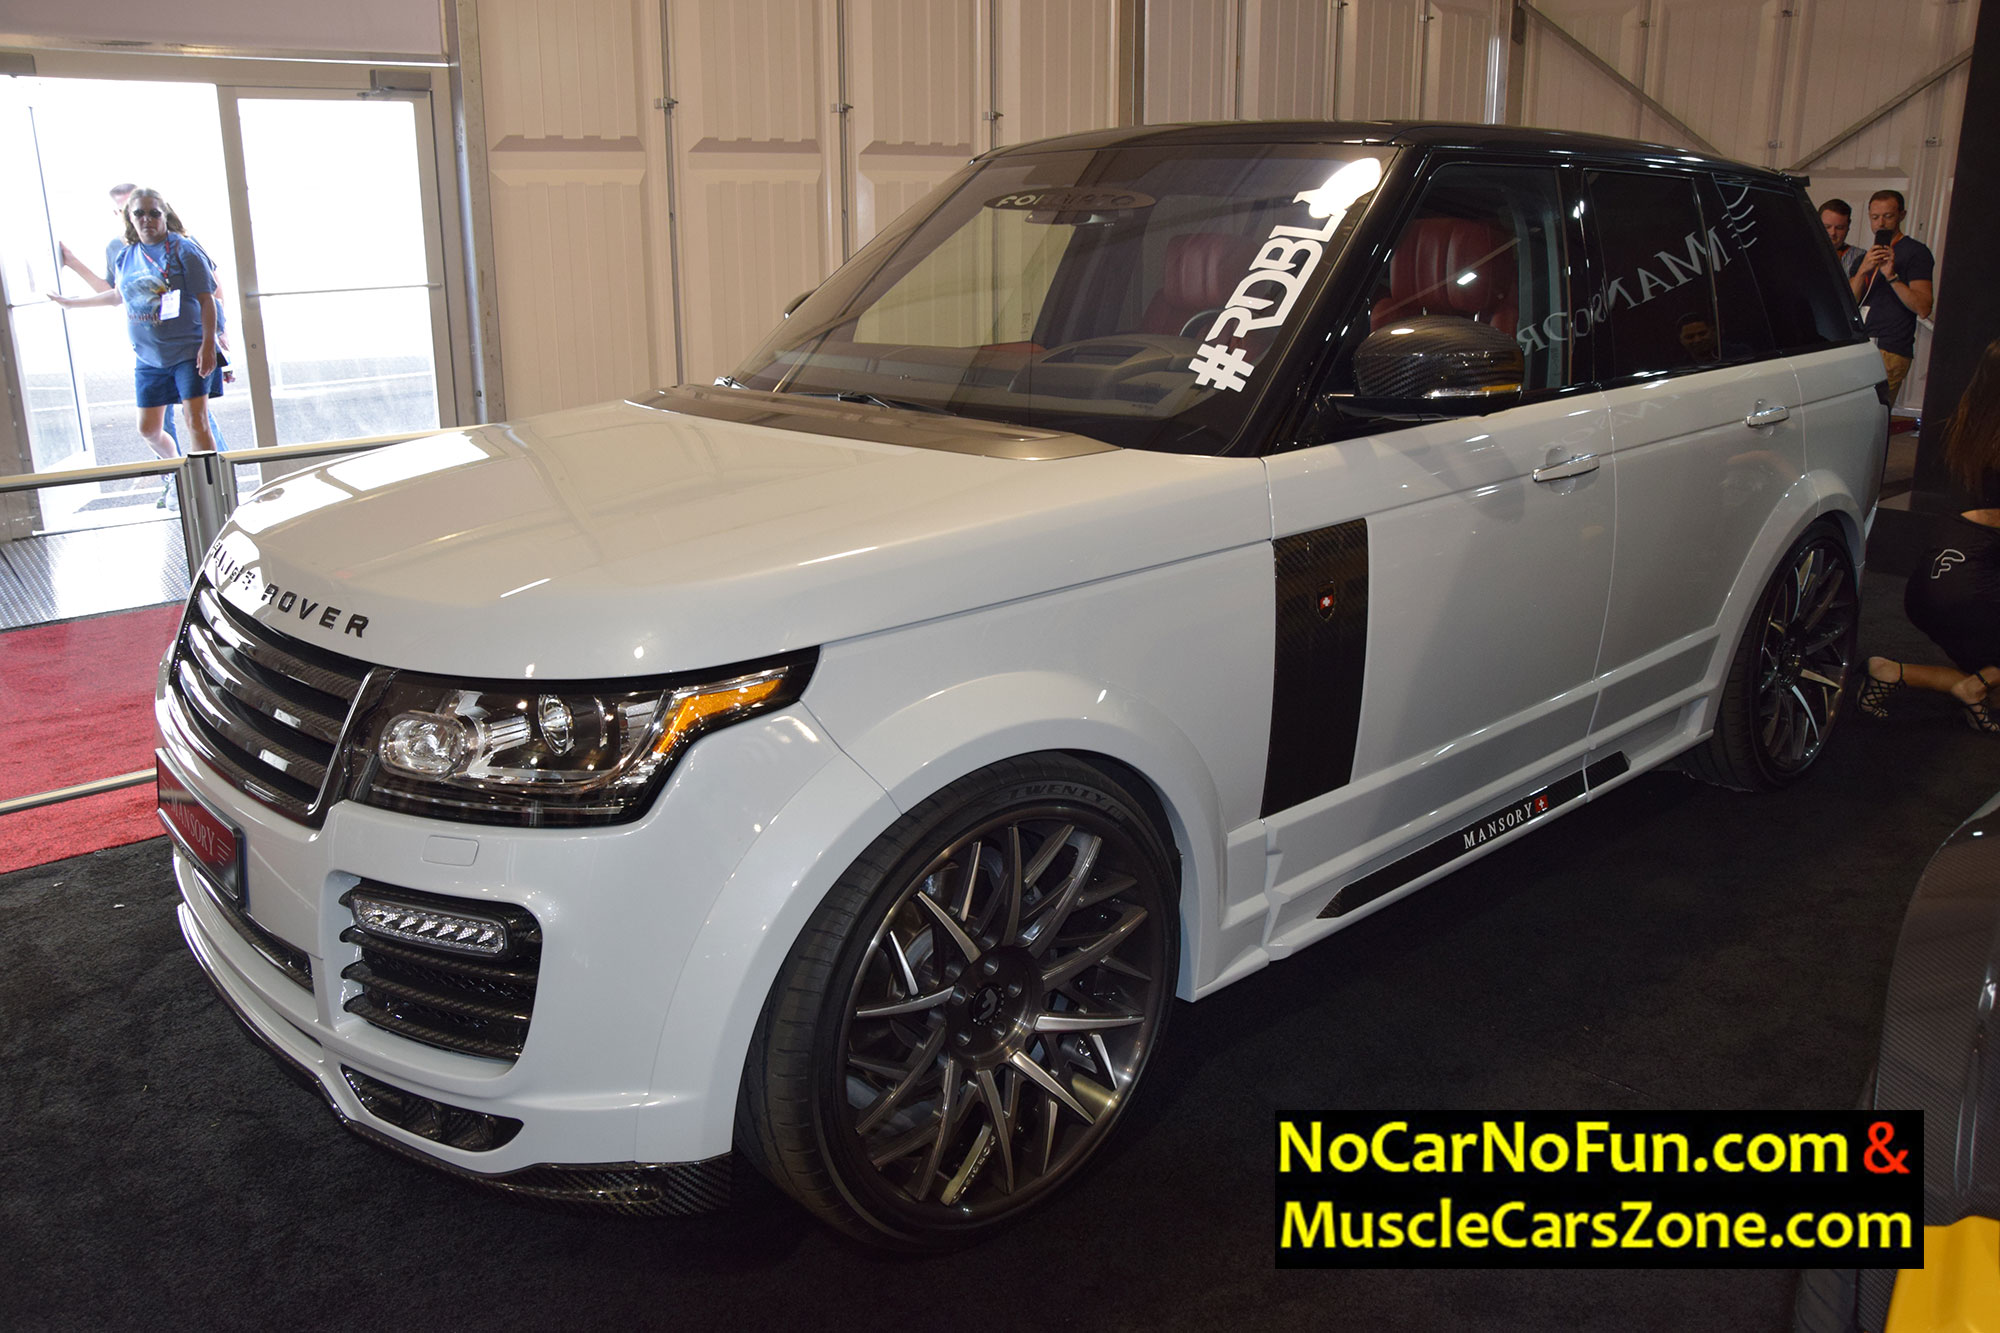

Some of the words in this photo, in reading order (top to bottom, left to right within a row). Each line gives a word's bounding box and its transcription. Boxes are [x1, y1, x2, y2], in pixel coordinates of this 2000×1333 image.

[261, 583, 369, 637] ROVER
[170, 794, 215, 856] MANSORY
[1463, 802, 1533, 850] MANSORY
